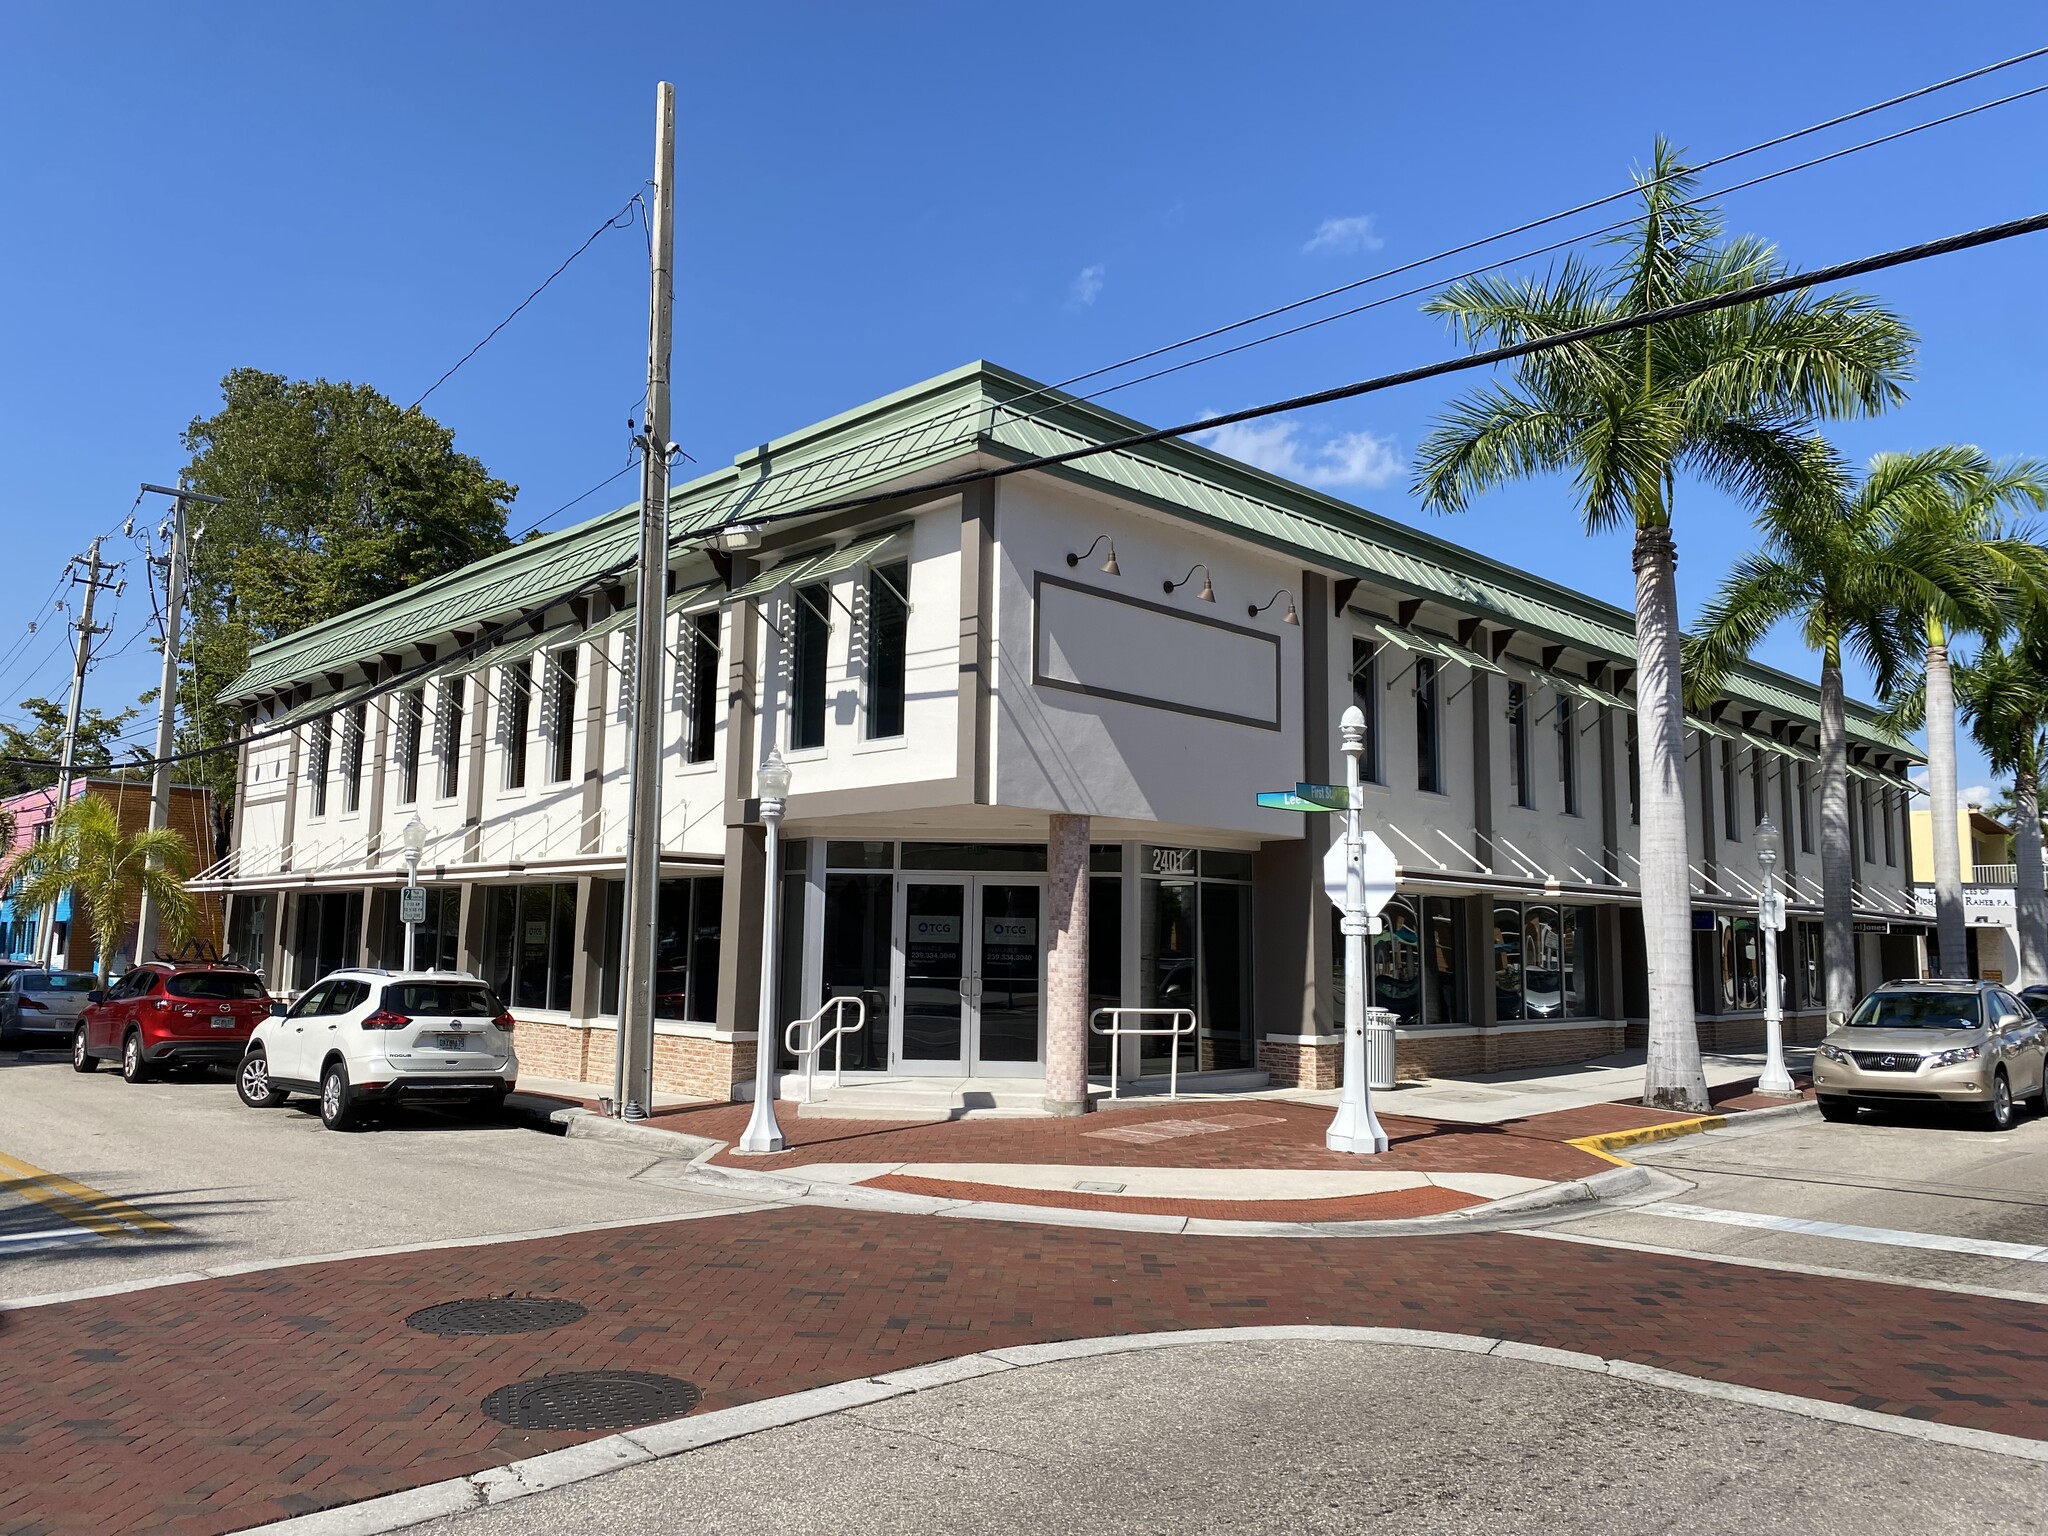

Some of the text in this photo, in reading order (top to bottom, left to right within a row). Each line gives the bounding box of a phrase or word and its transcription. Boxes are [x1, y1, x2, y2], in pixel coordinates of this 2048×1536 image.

[1311, 786, 1324, 799] First
[1284, 793, 1302, 805] Lee
[1152, 848, 1183, 873] 2401
[405, 889, 410, 900] 2
[929, 923, 951, 933] TCG
[1005, 925, 1027, 934] TCG
[911, 951, 957, 960] 239.334.3040
[987, 953, 1033, 961] 239.334.3040
